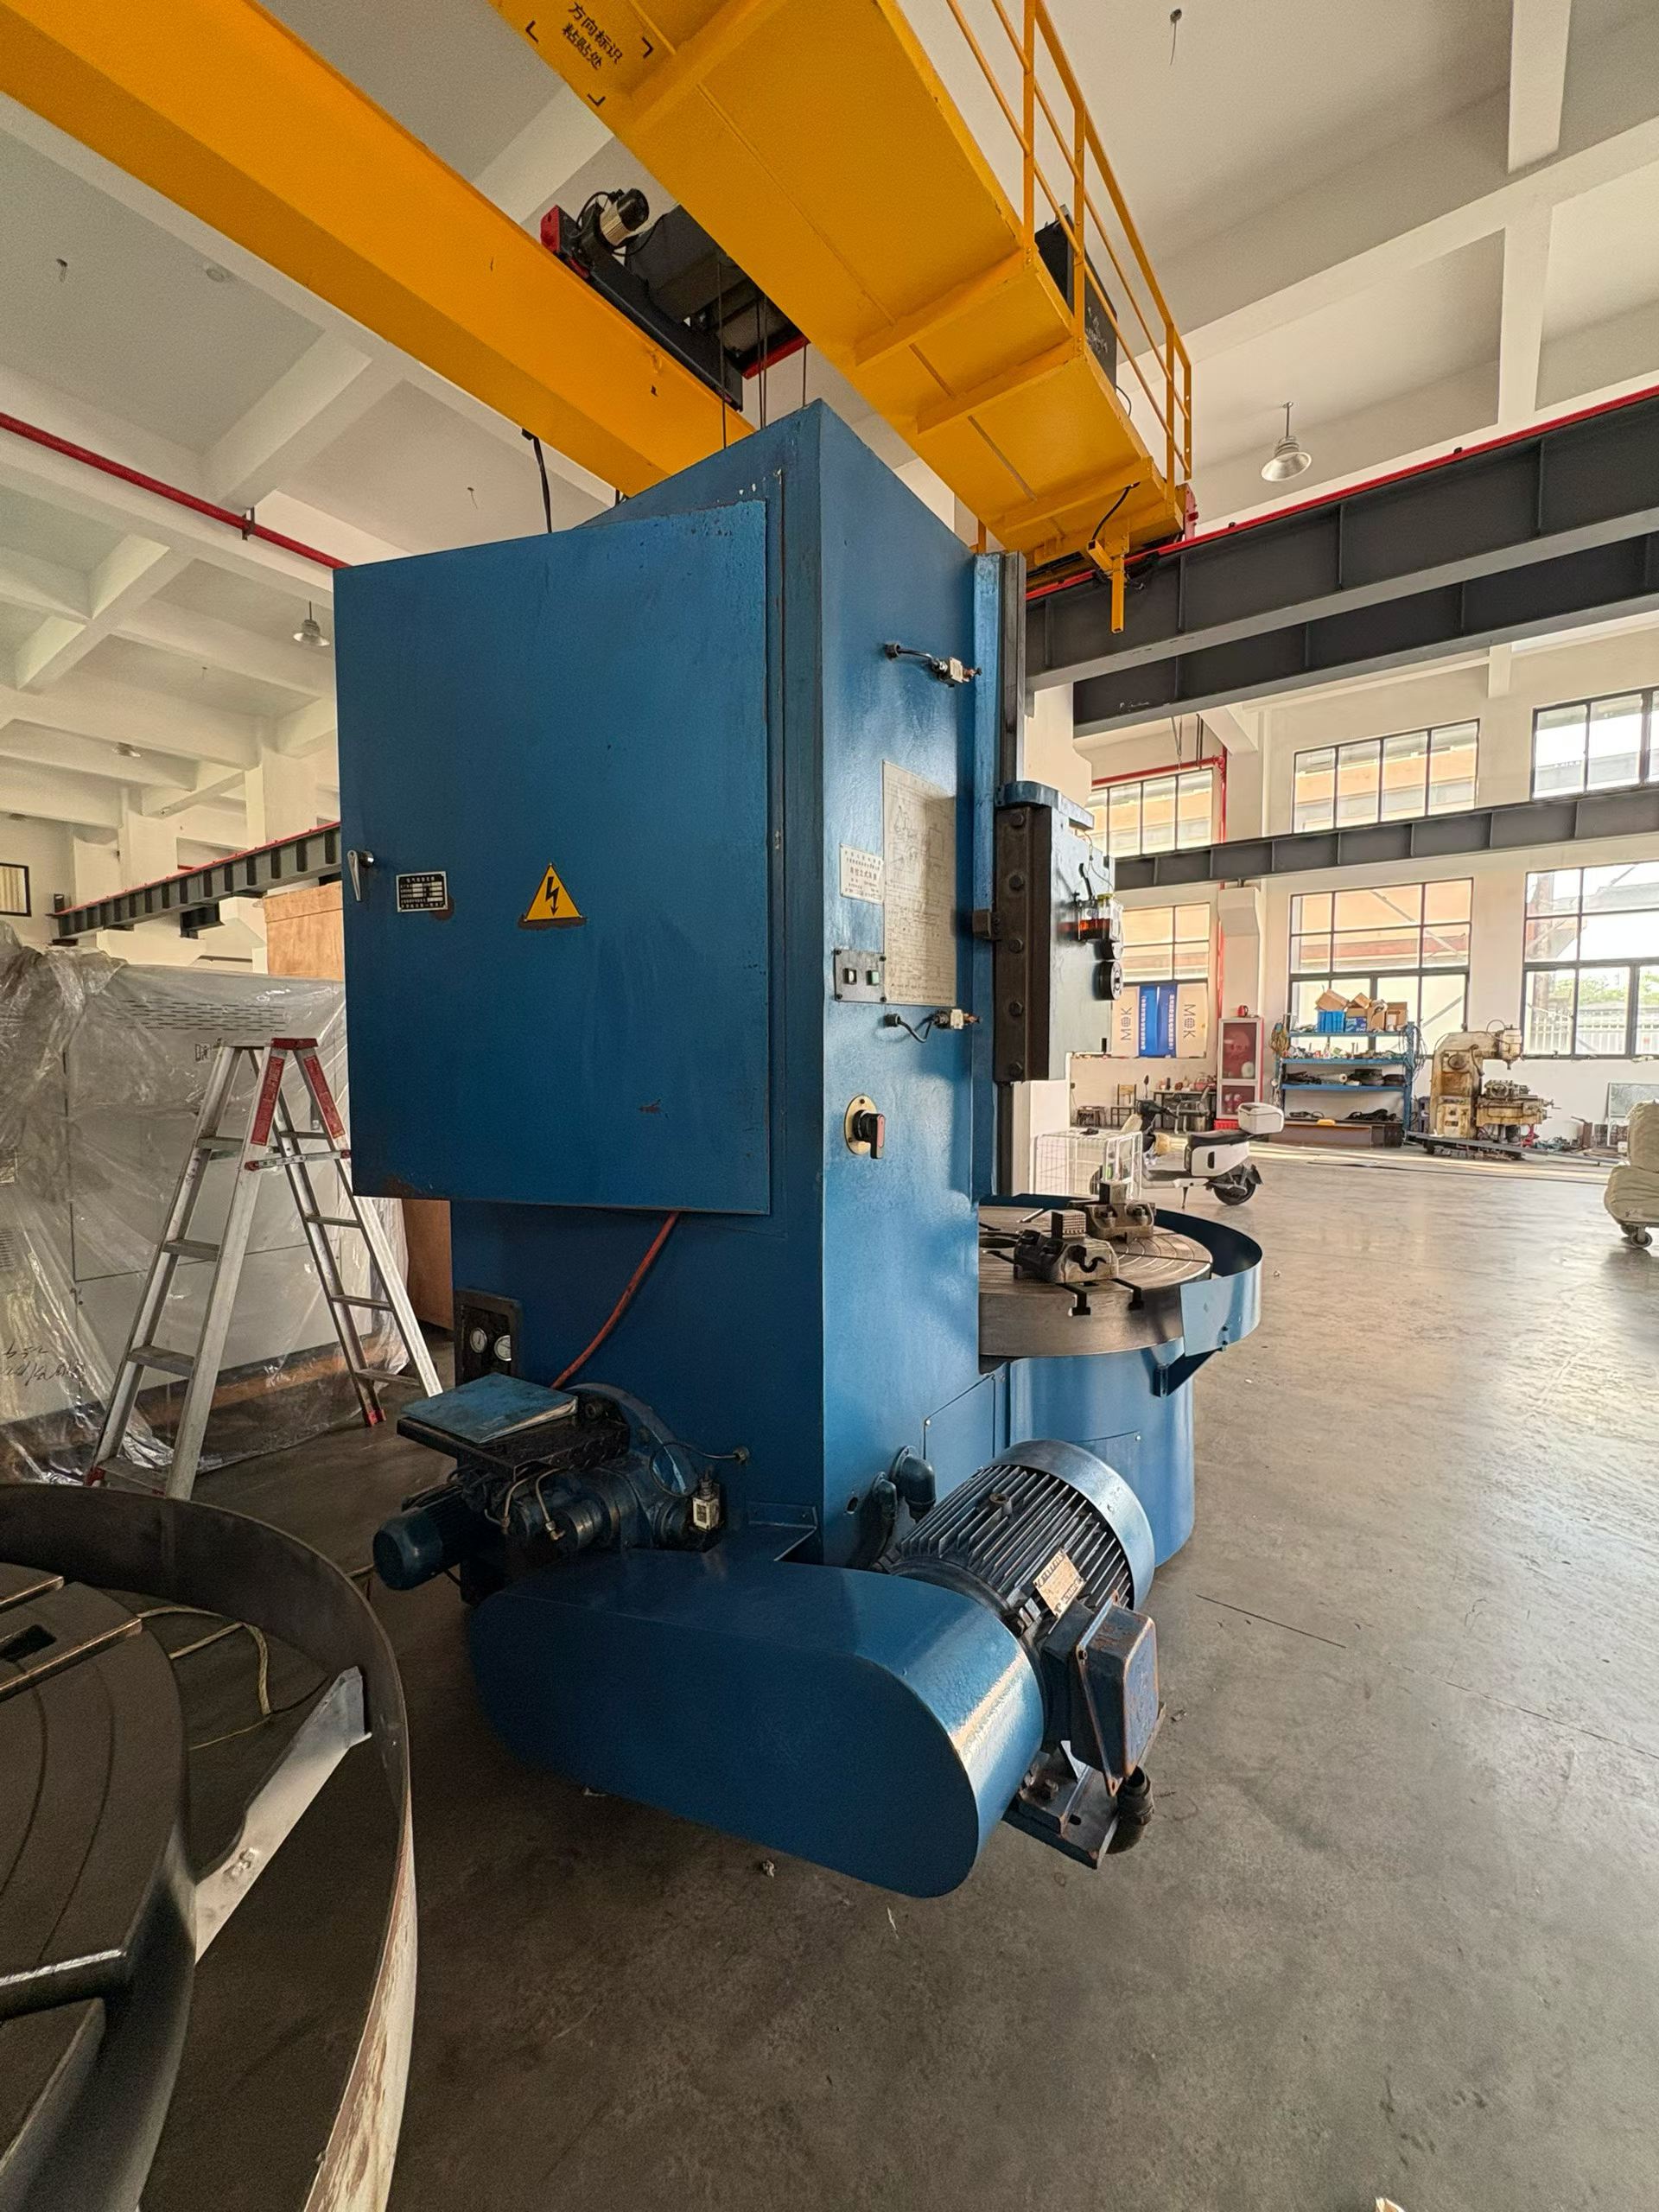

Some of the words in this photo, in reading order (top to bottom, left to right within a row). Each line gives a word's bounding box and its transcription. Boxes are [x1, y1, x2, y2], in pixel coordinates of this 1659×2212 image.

[562, 22, 602, 71] 粘贴处
[568, 2, 623, 65] 方向标识
